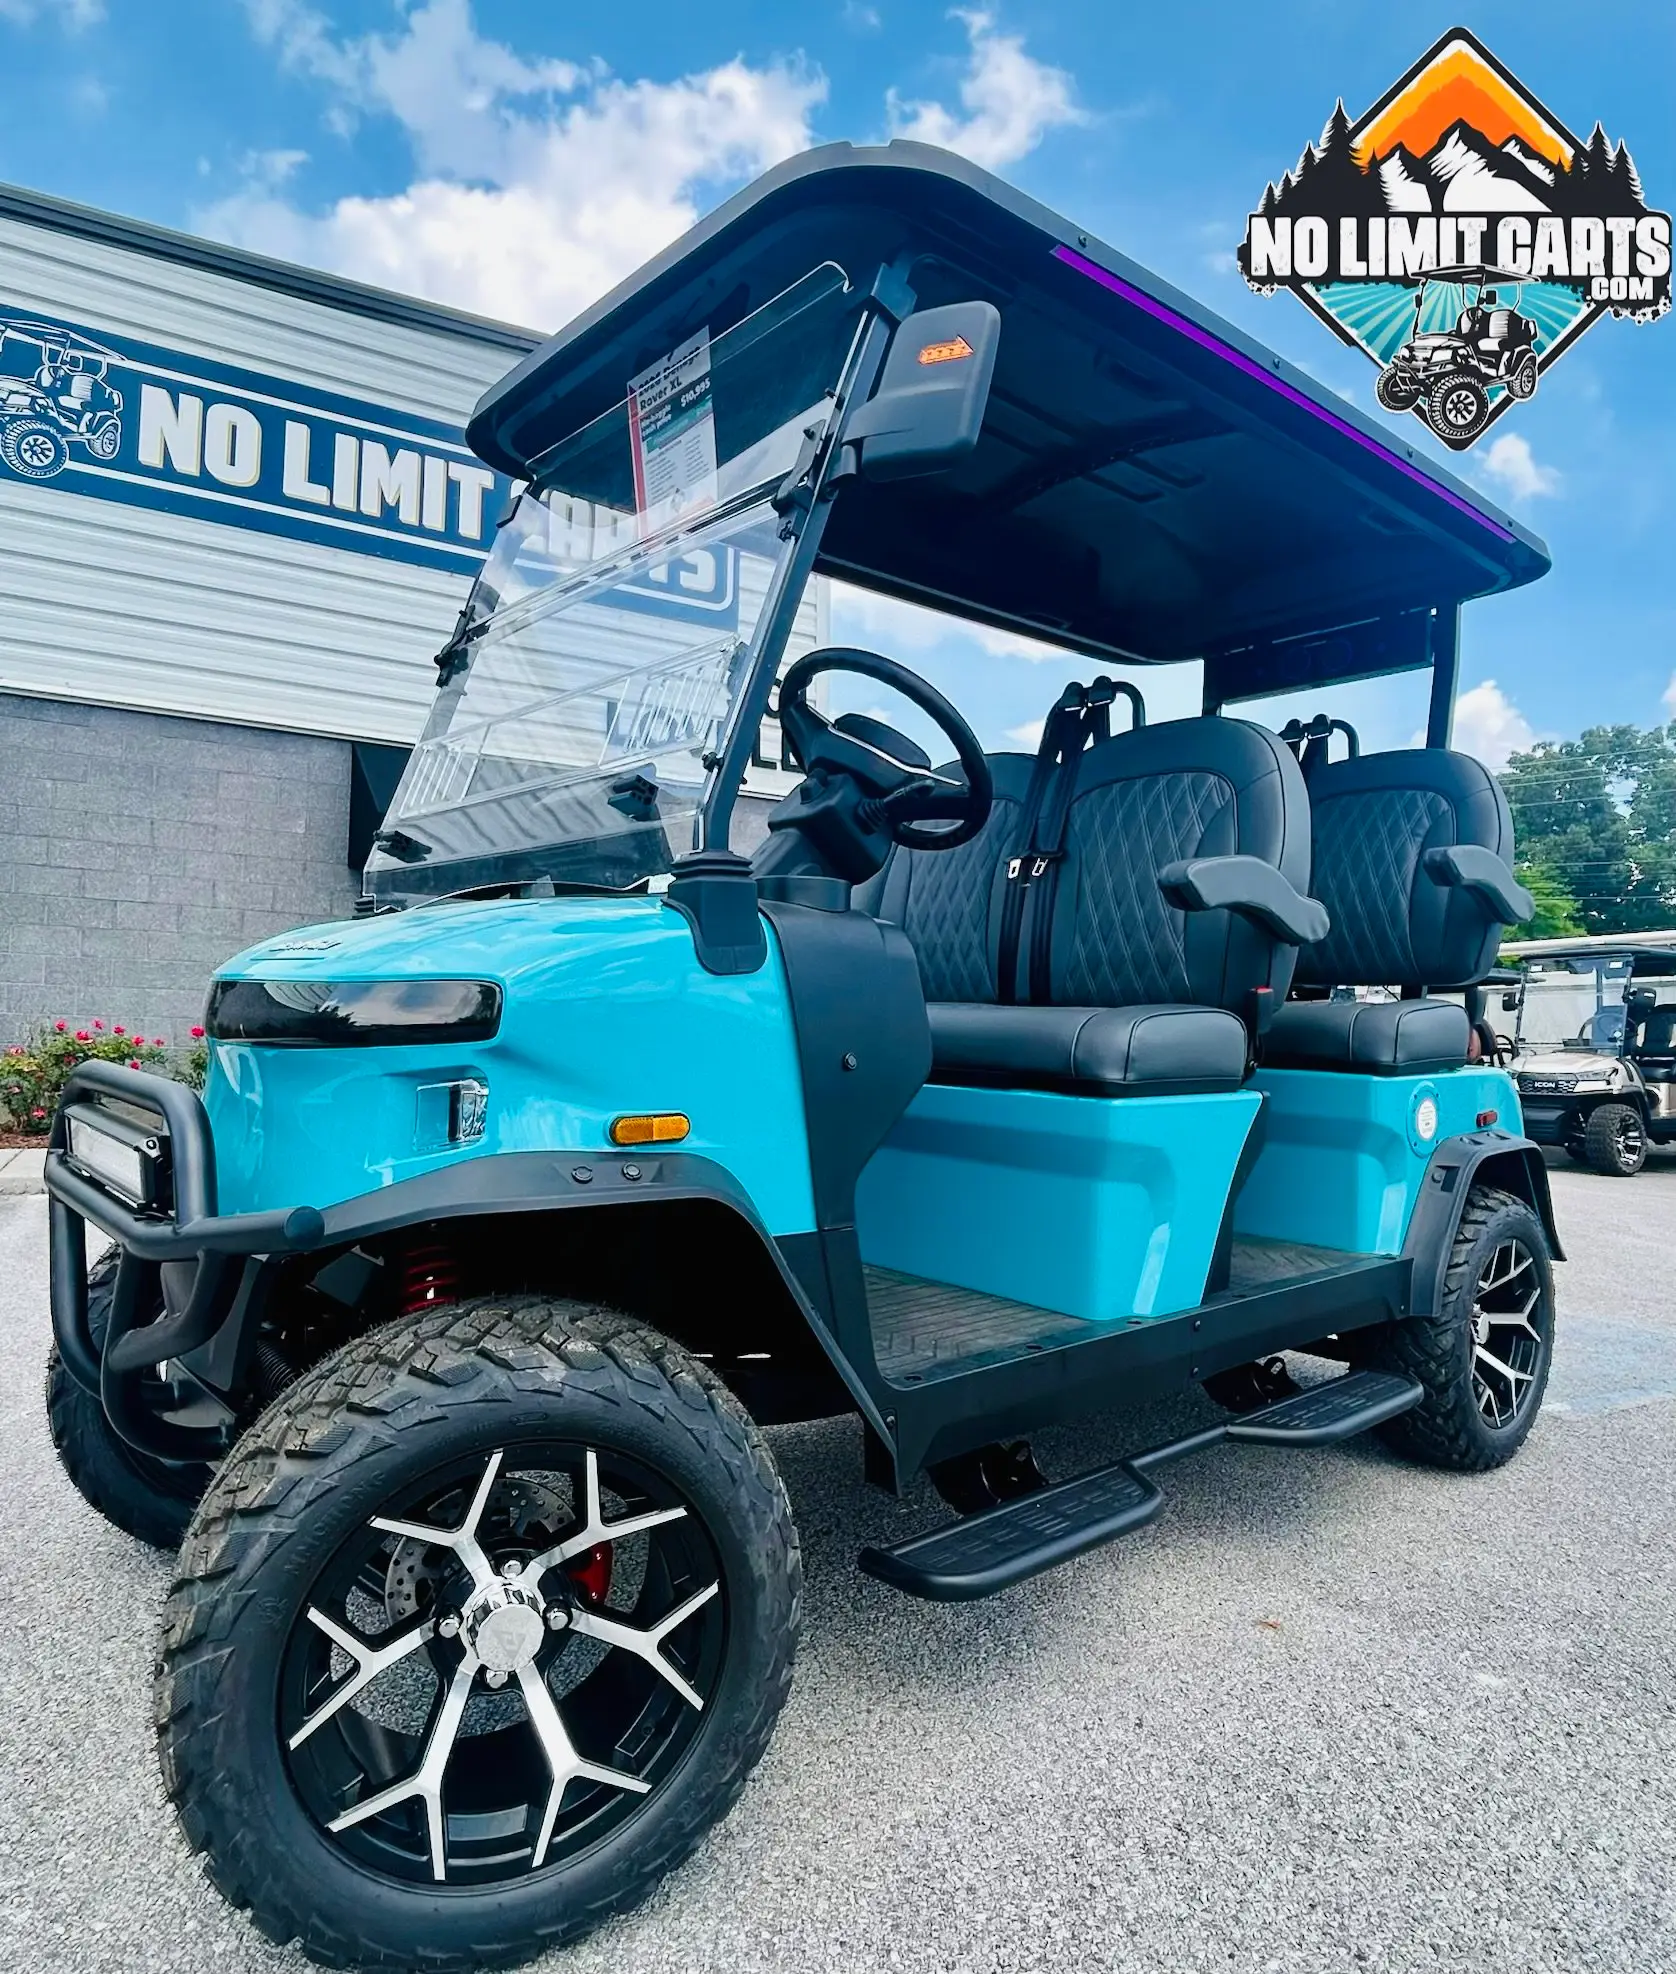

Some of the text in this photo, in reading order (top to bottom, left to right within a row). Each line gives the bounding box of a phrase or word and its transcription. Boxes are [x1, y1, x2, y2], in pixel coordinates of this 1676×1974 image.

[640, 375, 682, 411] Rover XL
[138, 383, 263, 488] NO
[282, 421, 494, 541] LIMIT
